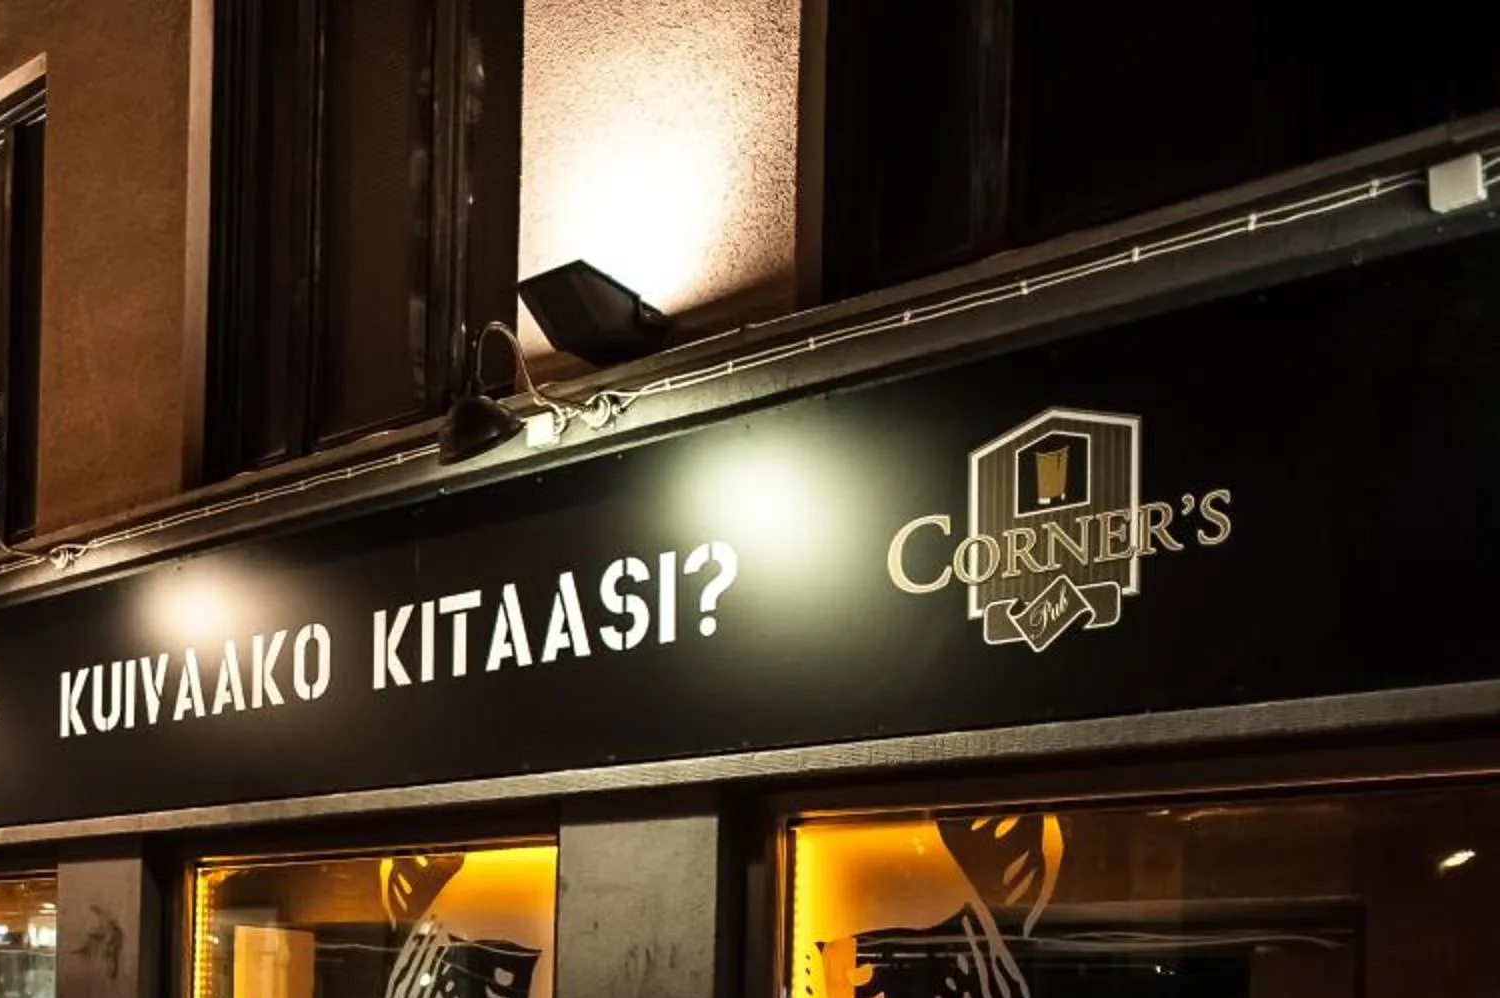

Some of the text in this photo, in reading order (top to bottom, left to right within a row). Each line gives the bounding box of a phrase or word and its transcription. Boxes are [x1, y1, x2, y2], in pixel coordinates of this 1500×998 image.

[886, 489, 1233, 594] CORNER'S
[59, 541, 739, 738] KUIVAAKO KITAASI?
[1028, 584, 1069, 638] Pub
